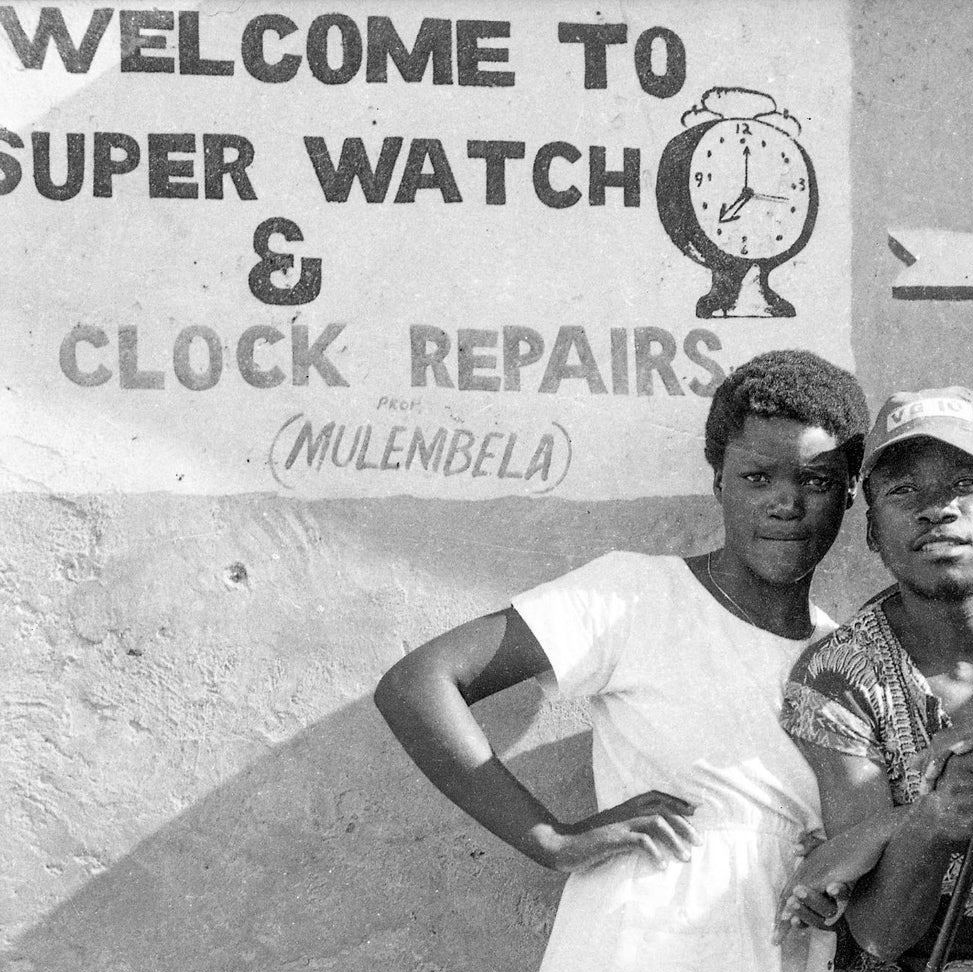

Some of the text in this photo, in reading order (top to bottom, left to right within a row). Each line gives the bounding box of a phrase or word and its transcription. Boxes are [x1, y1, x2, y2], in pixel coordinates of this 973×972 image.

[0, 7, 687, 99] WELCOME TO
[0, 129, 641, 209] SUPER WATCH
[248, 216, 322, 306] &
[59, 323, 727, 398] CLOCK REPAIRS
